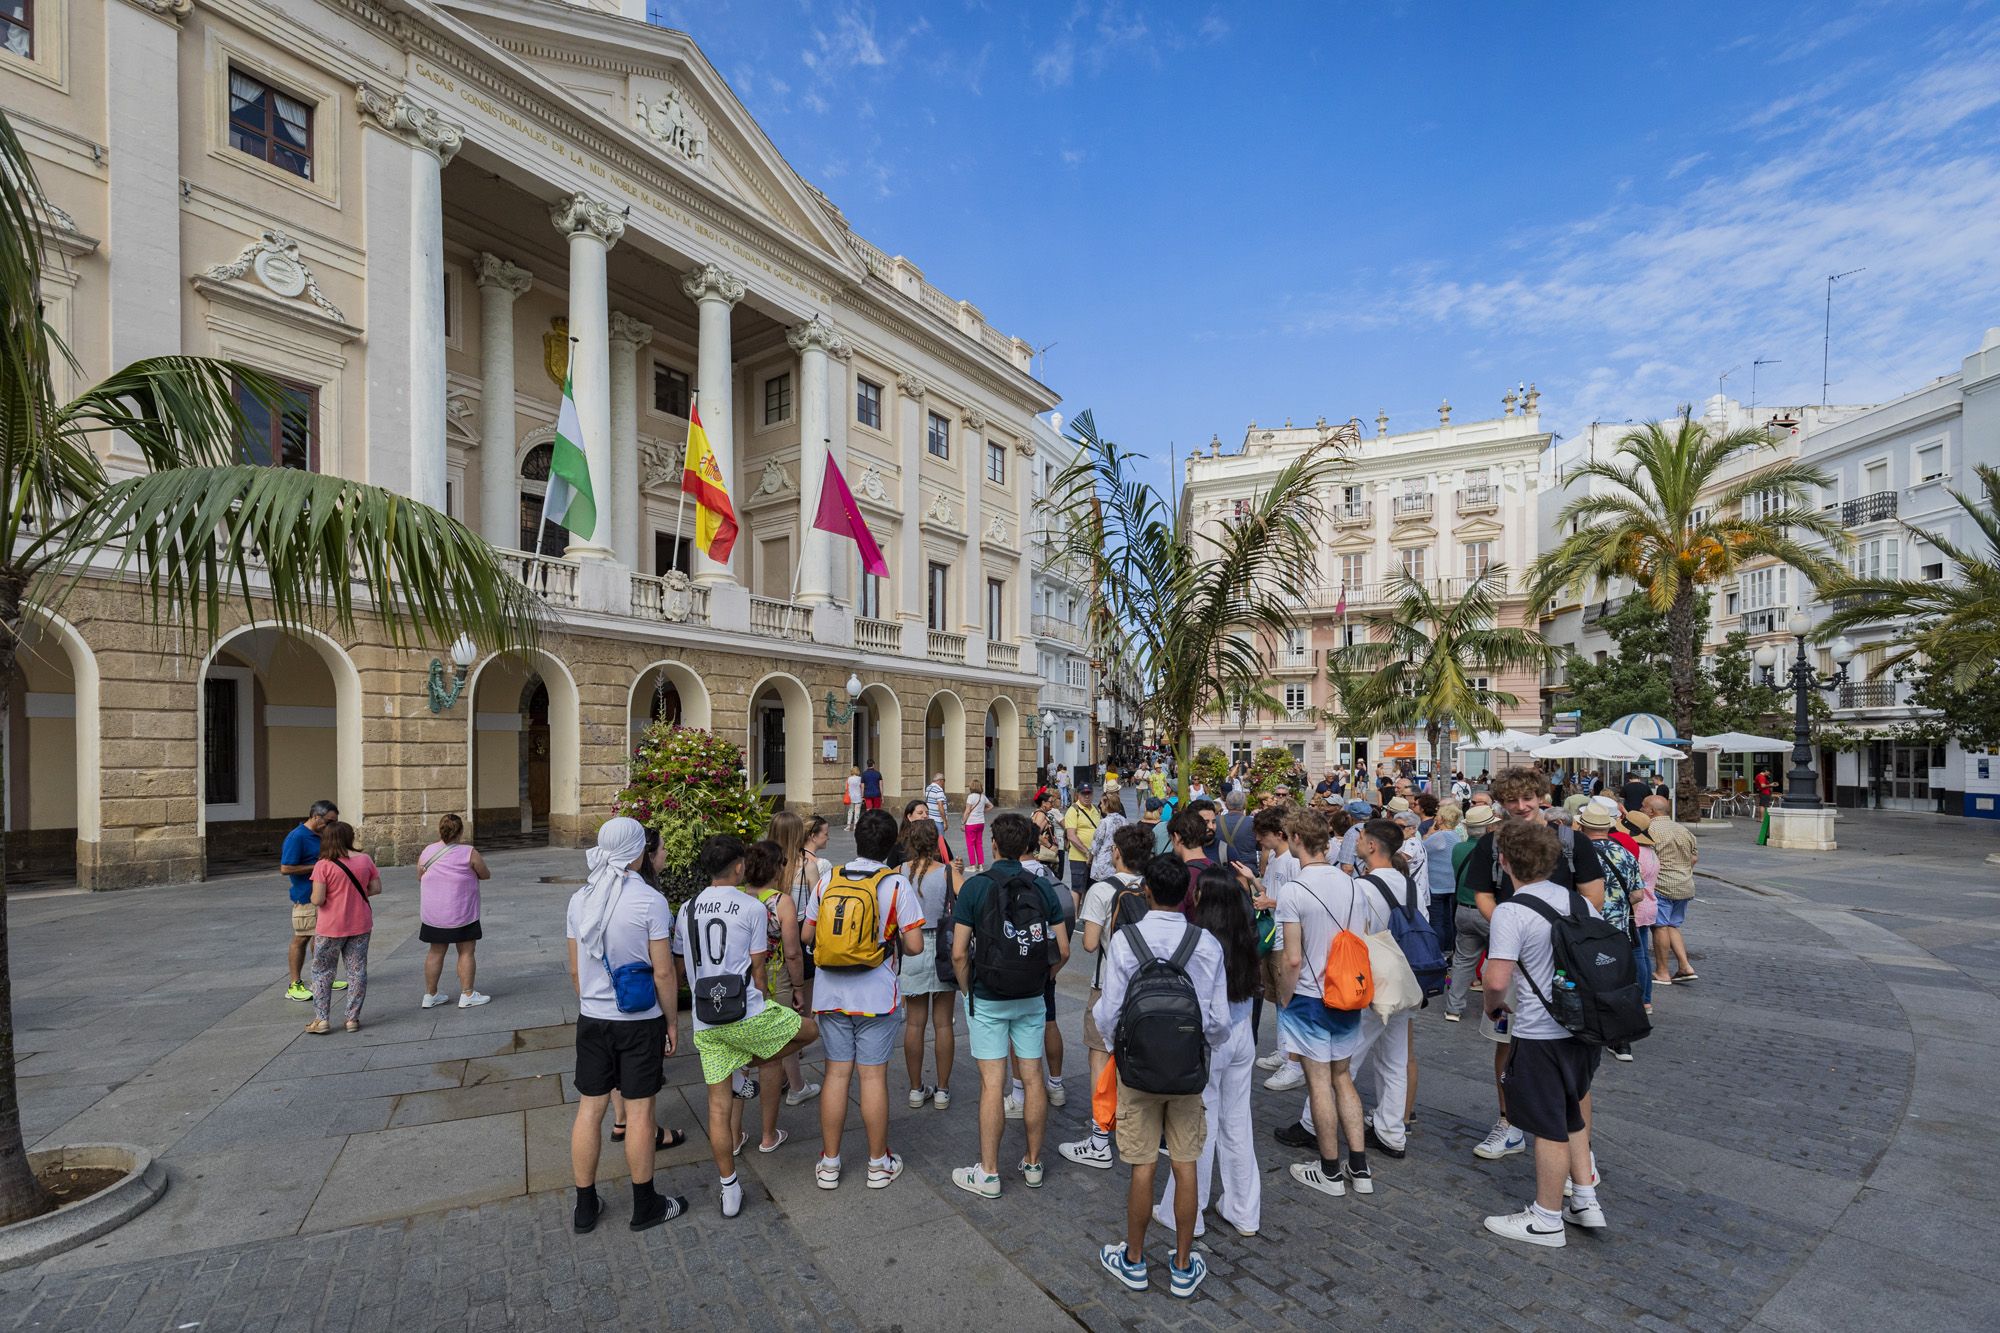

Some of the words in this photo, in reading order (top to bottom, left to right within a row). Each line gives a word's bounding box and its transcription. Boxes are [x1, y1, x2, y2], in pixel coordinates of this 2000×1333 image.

[416, 63, 454, 93] CASAS
[552, 140, 565, 156] DE
[570, 151, 584, 167] LA
[589, 163, 606, 179] MUI
[610, 173, 638, 197] NOBLE
[733, 244, 760, 267] CIUDAD
[683, 902, 721, 917] NYMAR
[724, 901, 740, 915] JR
[694, 917, 728, 967] 10
[1595, 957, 1617, 966] adidas
